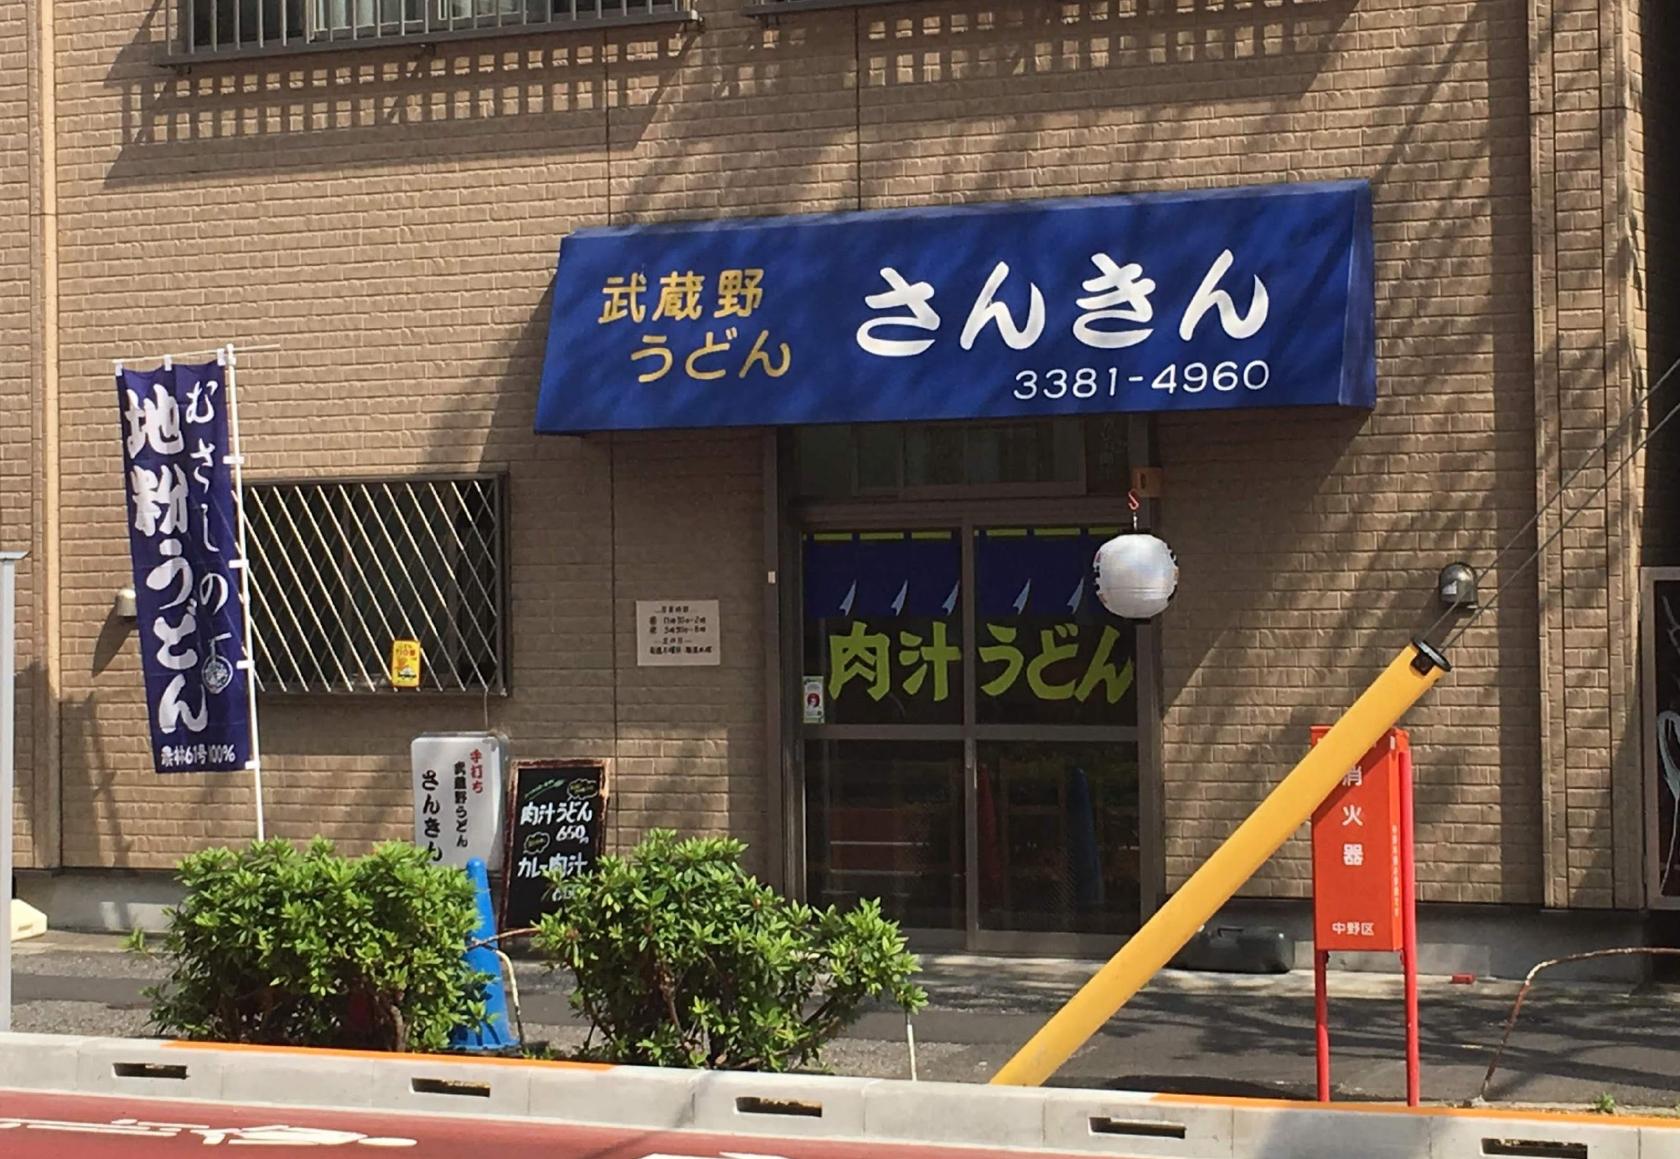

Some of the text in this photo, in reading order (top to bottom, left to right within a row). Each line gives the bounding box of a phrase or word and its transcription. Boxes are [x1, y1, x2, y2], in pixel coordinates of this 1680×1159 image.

[598, 267, 764, 323] 武蔵野
[855, 248, 1269, 357] さんきん
[630, 329, 791, 383] うどん
[1013, 359, 1270, 401] 3381-4960
[184, 380, 229, 615] むさしの
[125, 383, 209, 735] 地粉うどん
[828, 621, 1134, 704] 肉汁うどん
[470, 749, 483, 794] 手打ち
[422, 769, 443, 862] さんきん
[520, 801, 593, 826] 肉汁うどん
[1331, 921, 1375, 936] 中野区
